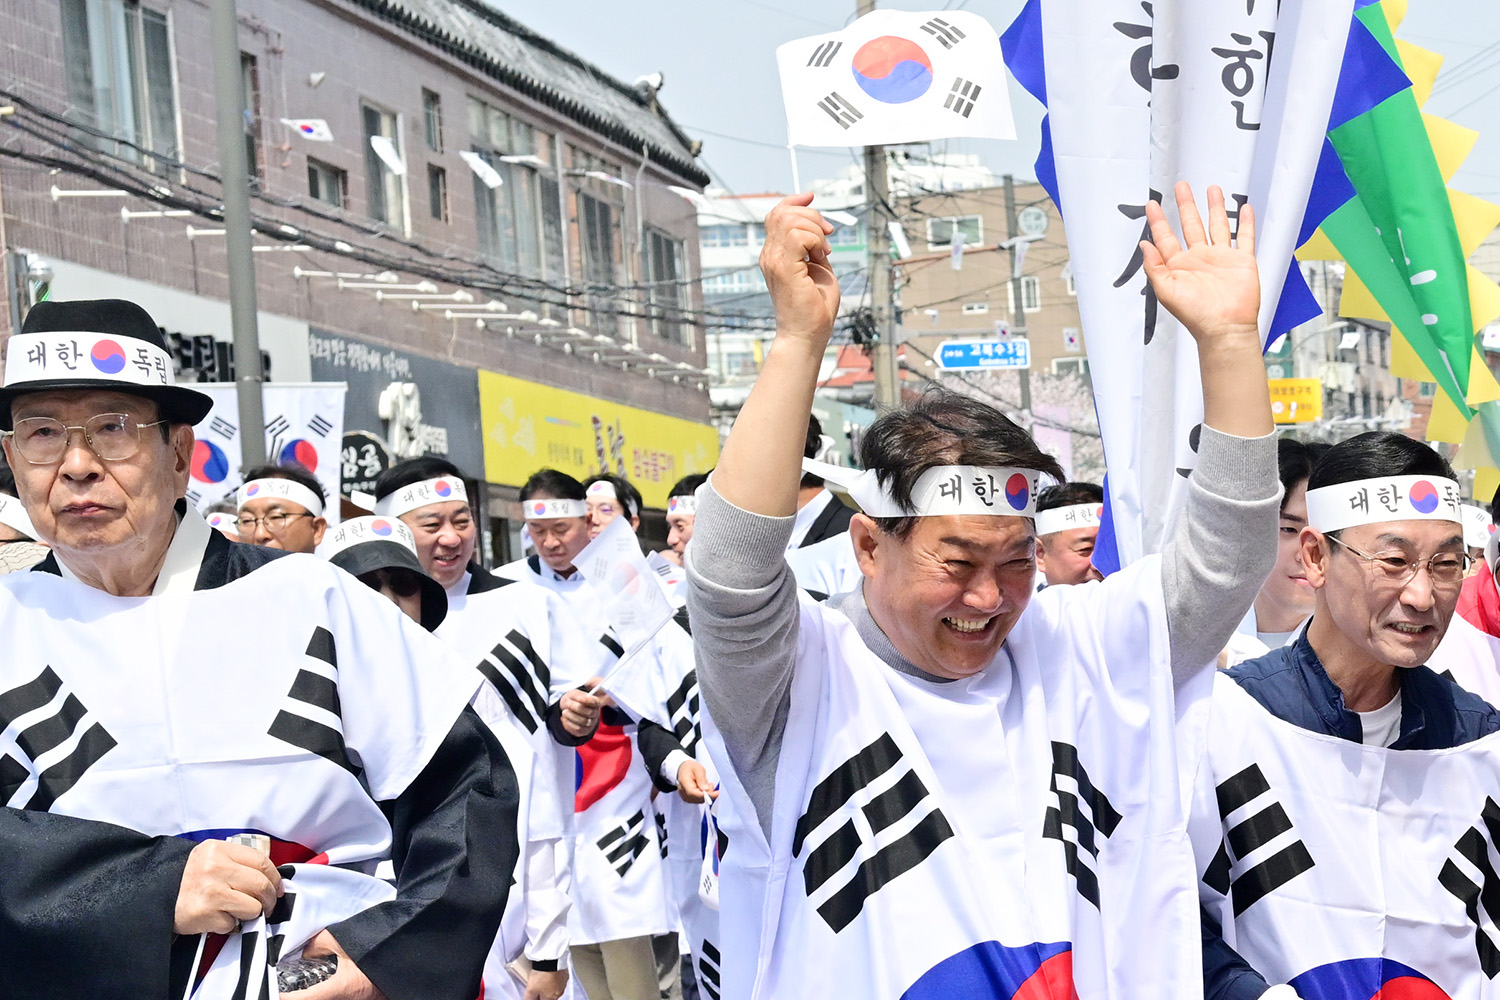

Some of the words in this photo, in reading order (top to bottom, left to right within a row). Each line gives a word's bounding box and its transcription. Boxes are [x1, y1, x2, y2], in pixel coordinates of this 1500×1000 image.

[27, 340, 83, 371] 대한
[132, 346, 168, 385] 독립
[938, 474, 999, 507] 대한
[1349, 484, 1403, 515] 대한
[1065, 508, 1092, 523] 대한
